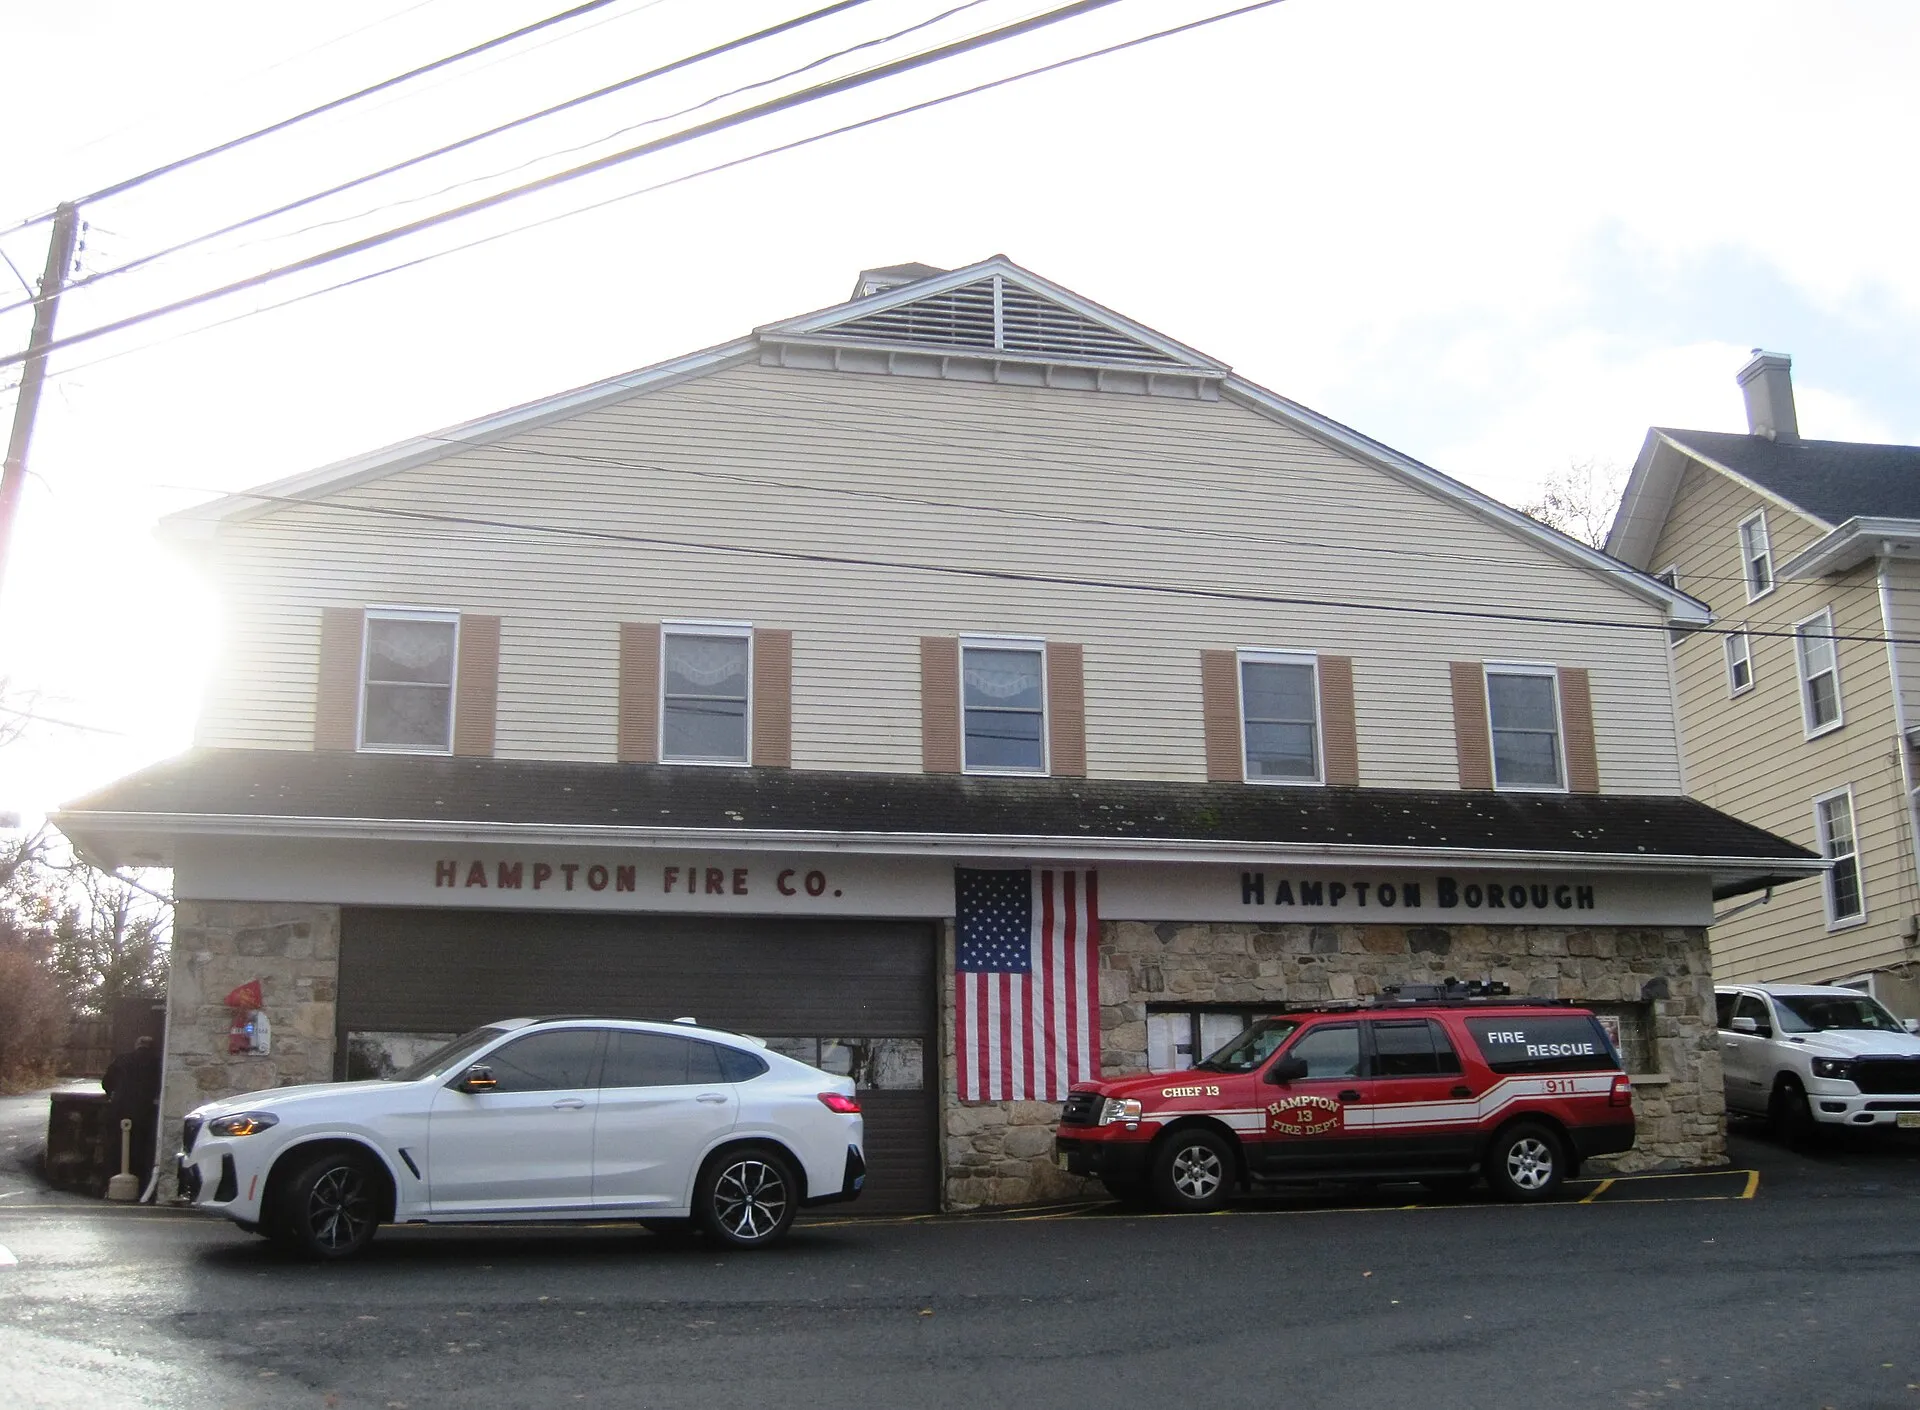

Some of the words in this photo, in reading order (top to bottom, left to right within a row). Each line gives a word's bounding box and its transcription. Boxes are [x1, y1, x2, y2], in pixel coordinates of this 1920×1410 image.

[435, 860, 637, 891] HAMPTON
[663, 866, 749, 895] FIRE
[776, 869, 843, 897] CO.
[1241, 872, 1421, 908] HAMPTON
[1437, 877, 1595, 910] BOROUGH
[1488, 1031, 1526, 1044] FIRE
[1527, 1043, 1594, 1057] RESCUE
[1162, 1087, 1203, 1098] CHIEF
[1206, 1085, 1220, 1096] 13
[1546, 1080, 1575, 1093] 911
[1267, 1095, 1340, 1115] HAMPTON
[1297, 1109, 1313, 1122] 13
[1271, 1119, 1302, 1135] FIRE
[1305, 1117, 1341, 1135] DEPT.
